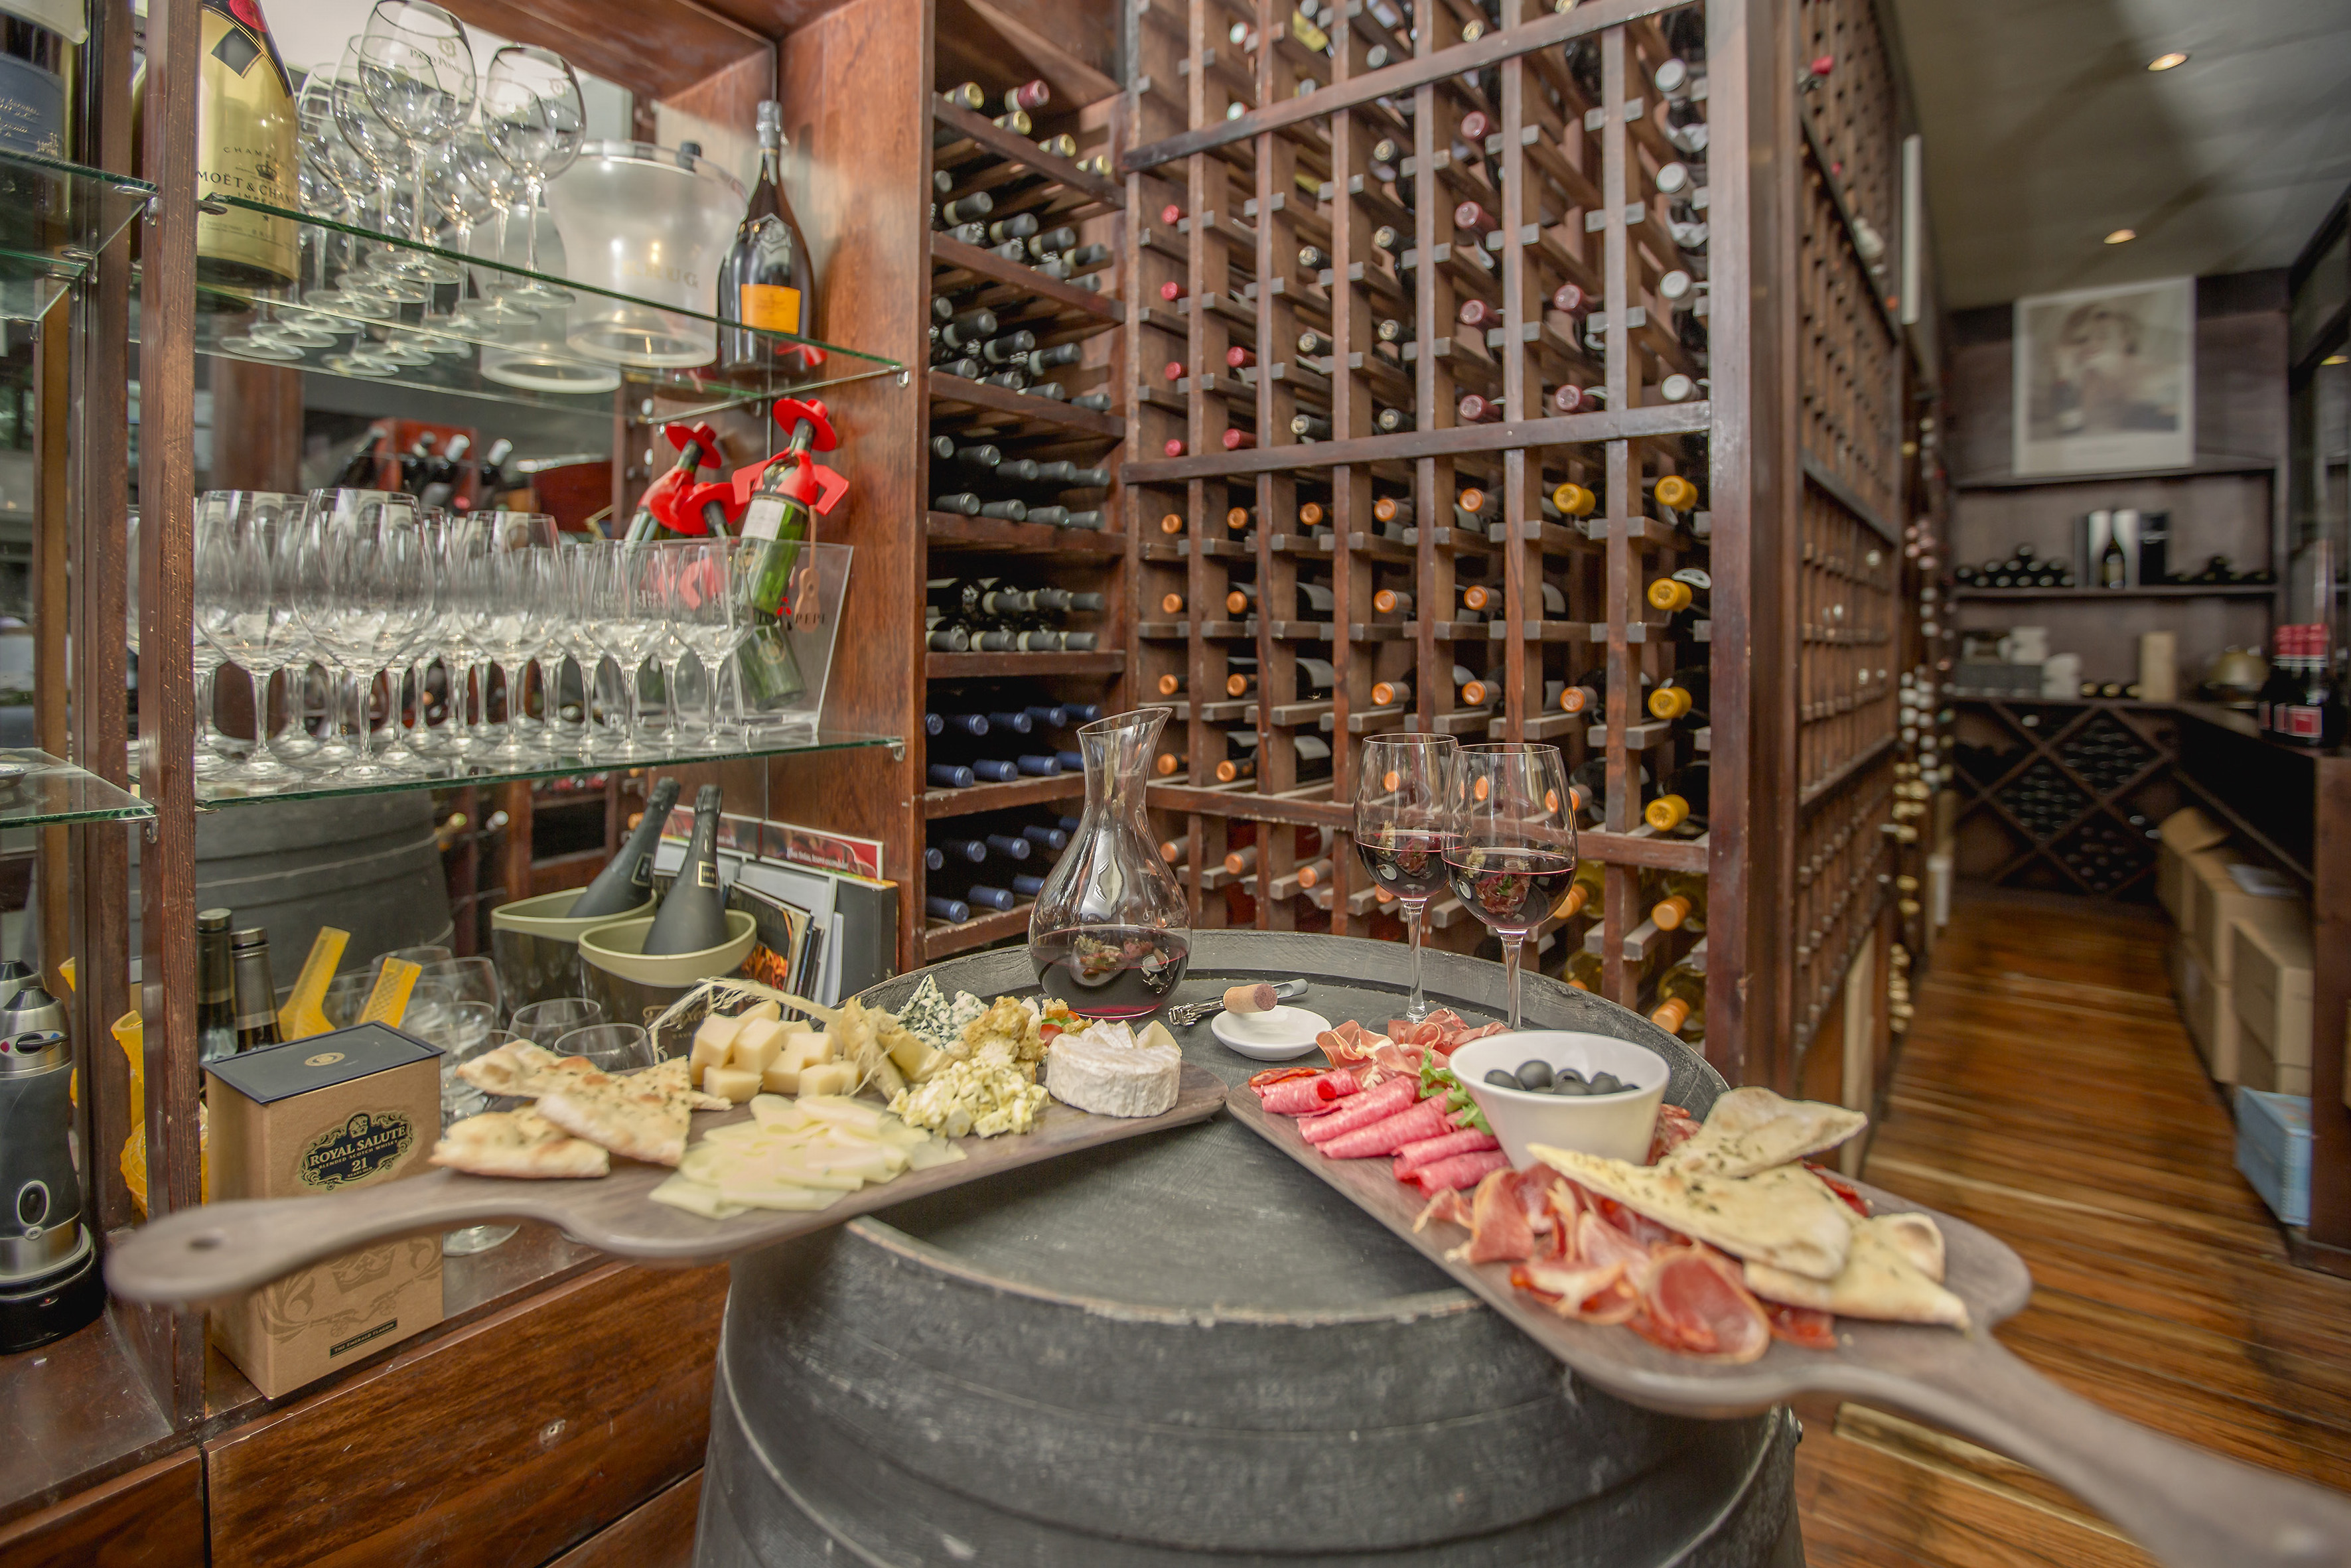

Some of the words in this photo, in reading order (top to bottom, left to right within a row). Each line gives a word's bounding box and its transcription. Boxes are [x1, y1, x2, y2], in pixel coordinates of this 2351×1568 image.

[196, 170, 244, 188] MOËT
[246, 182, 255, 192] &
[259, 184, 293, 204] CHAN
[621, 261, 699, 288] KRUG
[309, 1143, 356, 1167] ROYAL
[356, 1125, 407, 1151] SALUTE
[319, 1156, 347, 1169] BLENDED
[349, 1148, 374, 1159] SCOTCH
[375, 1139, 398, 1151] WHISKY
[351, 1157, 368, 1173] 21
[334, 1344, 346, 1353] THE
[346, 1332, 372, 1348] EMERALD
[372, 1322, 395, 1336] FLAGON
